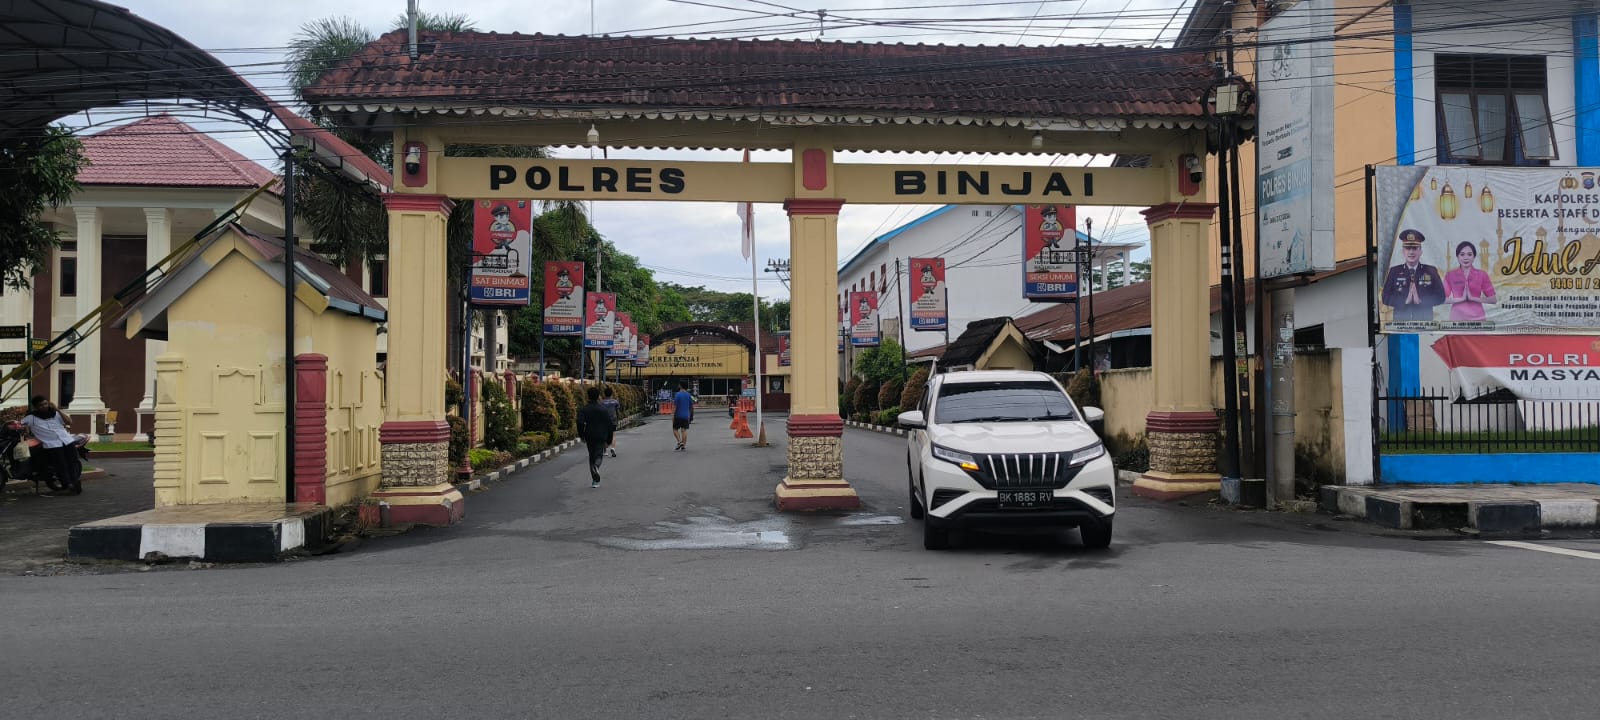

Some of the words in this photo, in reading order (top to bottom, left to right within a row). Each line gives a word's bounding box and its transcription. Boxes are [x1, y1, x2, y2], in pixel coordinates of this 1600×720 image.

[490, 164, 685, 194] POLRES
[894, 171, 1093, 197] BINJAI
[1262, 175, 1286, 199] POLRES
[1287, 167, 1309, 192] BINJAI
[1535, 194, 1599, 204] KAPOLRES
[1498, 209, 1549, 218] BESERTA
[1553, 209, 1588, 218] STAFF
[1501, 236, 1581, 275] Idul
[475, 277, 490, 285] SAT
[492, 278, 525, 286] BINMAS
[1049, 273, 1073, 281] UMUM
[1047, 283, 1066, 291] BRI
[1550, 277, 1573, 290] 1446
[1575, 277, 1583, 290] H
[495, 288, 516, 297] BRI
[1509, 353, 1588, 365] POLRI
[1510, 369, 1600, 381] MASYA
[1000, 492, 1012, 502] BK
[1040, 492, 1052, 502] RV
